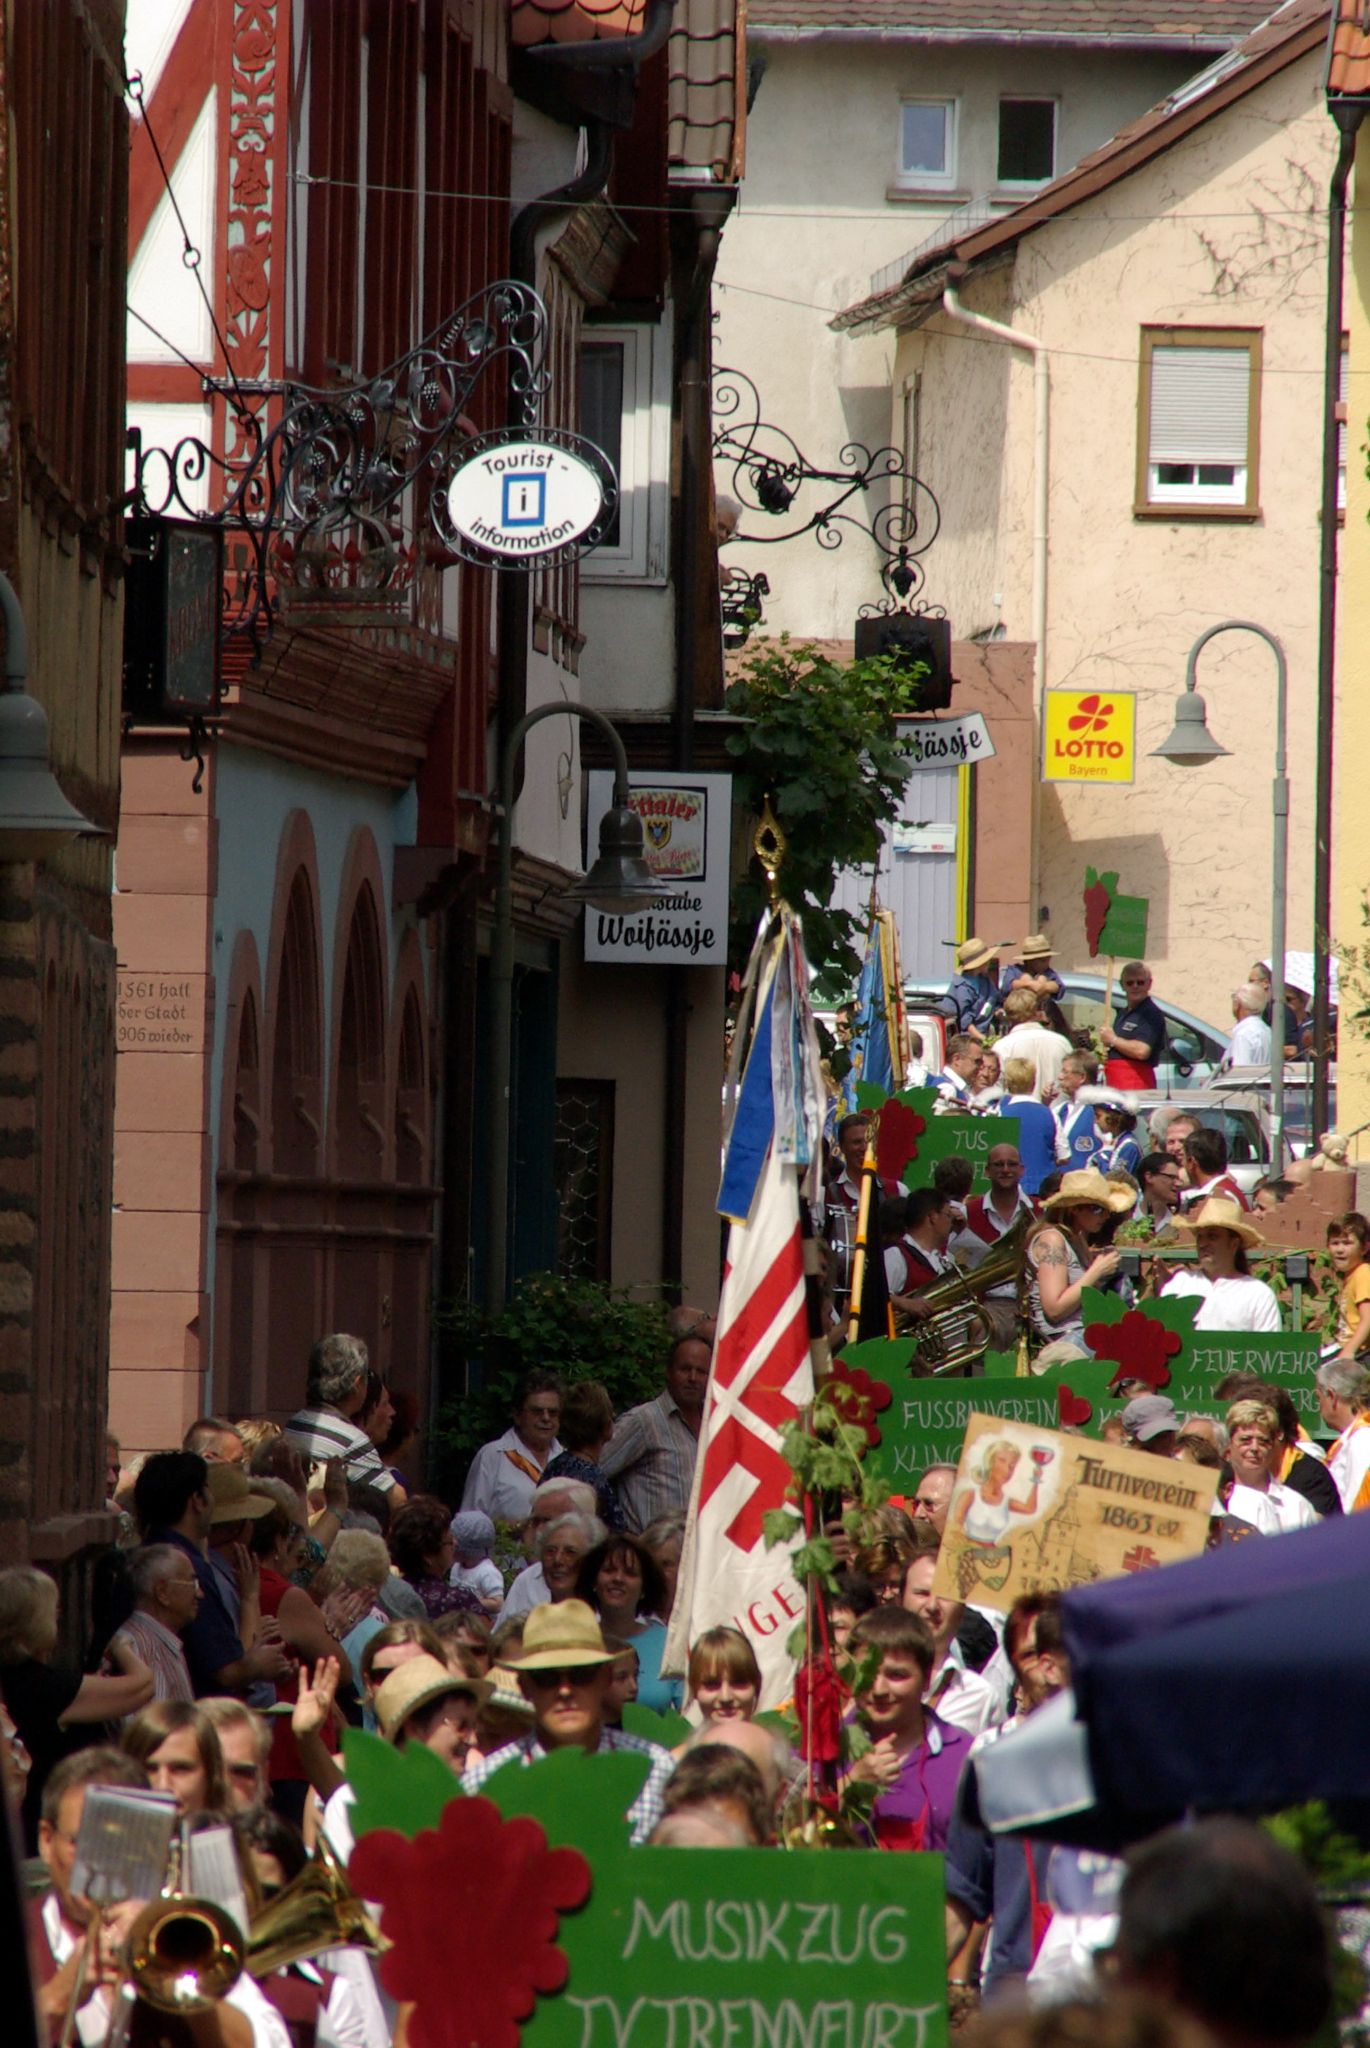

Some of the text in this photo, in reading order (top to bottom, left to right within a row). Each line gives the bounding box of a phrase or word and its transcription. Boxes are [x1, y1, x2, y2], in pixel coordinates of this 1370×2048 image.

[469, 516, 576, 550] information
[1054, 739, 1125, 759] LOTTO
[1068, 764, 1108, 777] Bayern
[597, 914, 716, 955] Woifässje
[144, 1004, 186, 1020] Stadt
[148, 1028, 193, 1043] wieder
[952, 1130, 988, 1151] TUS
[1188, 1349, 1320, 1373] FEUERWEHR
[1075, 1453, 1198, 1509] Turnverein
[1101, 1504, 1156, 1535] 1863
[566, 1995, 941, 2048] TV TRENNFURT
